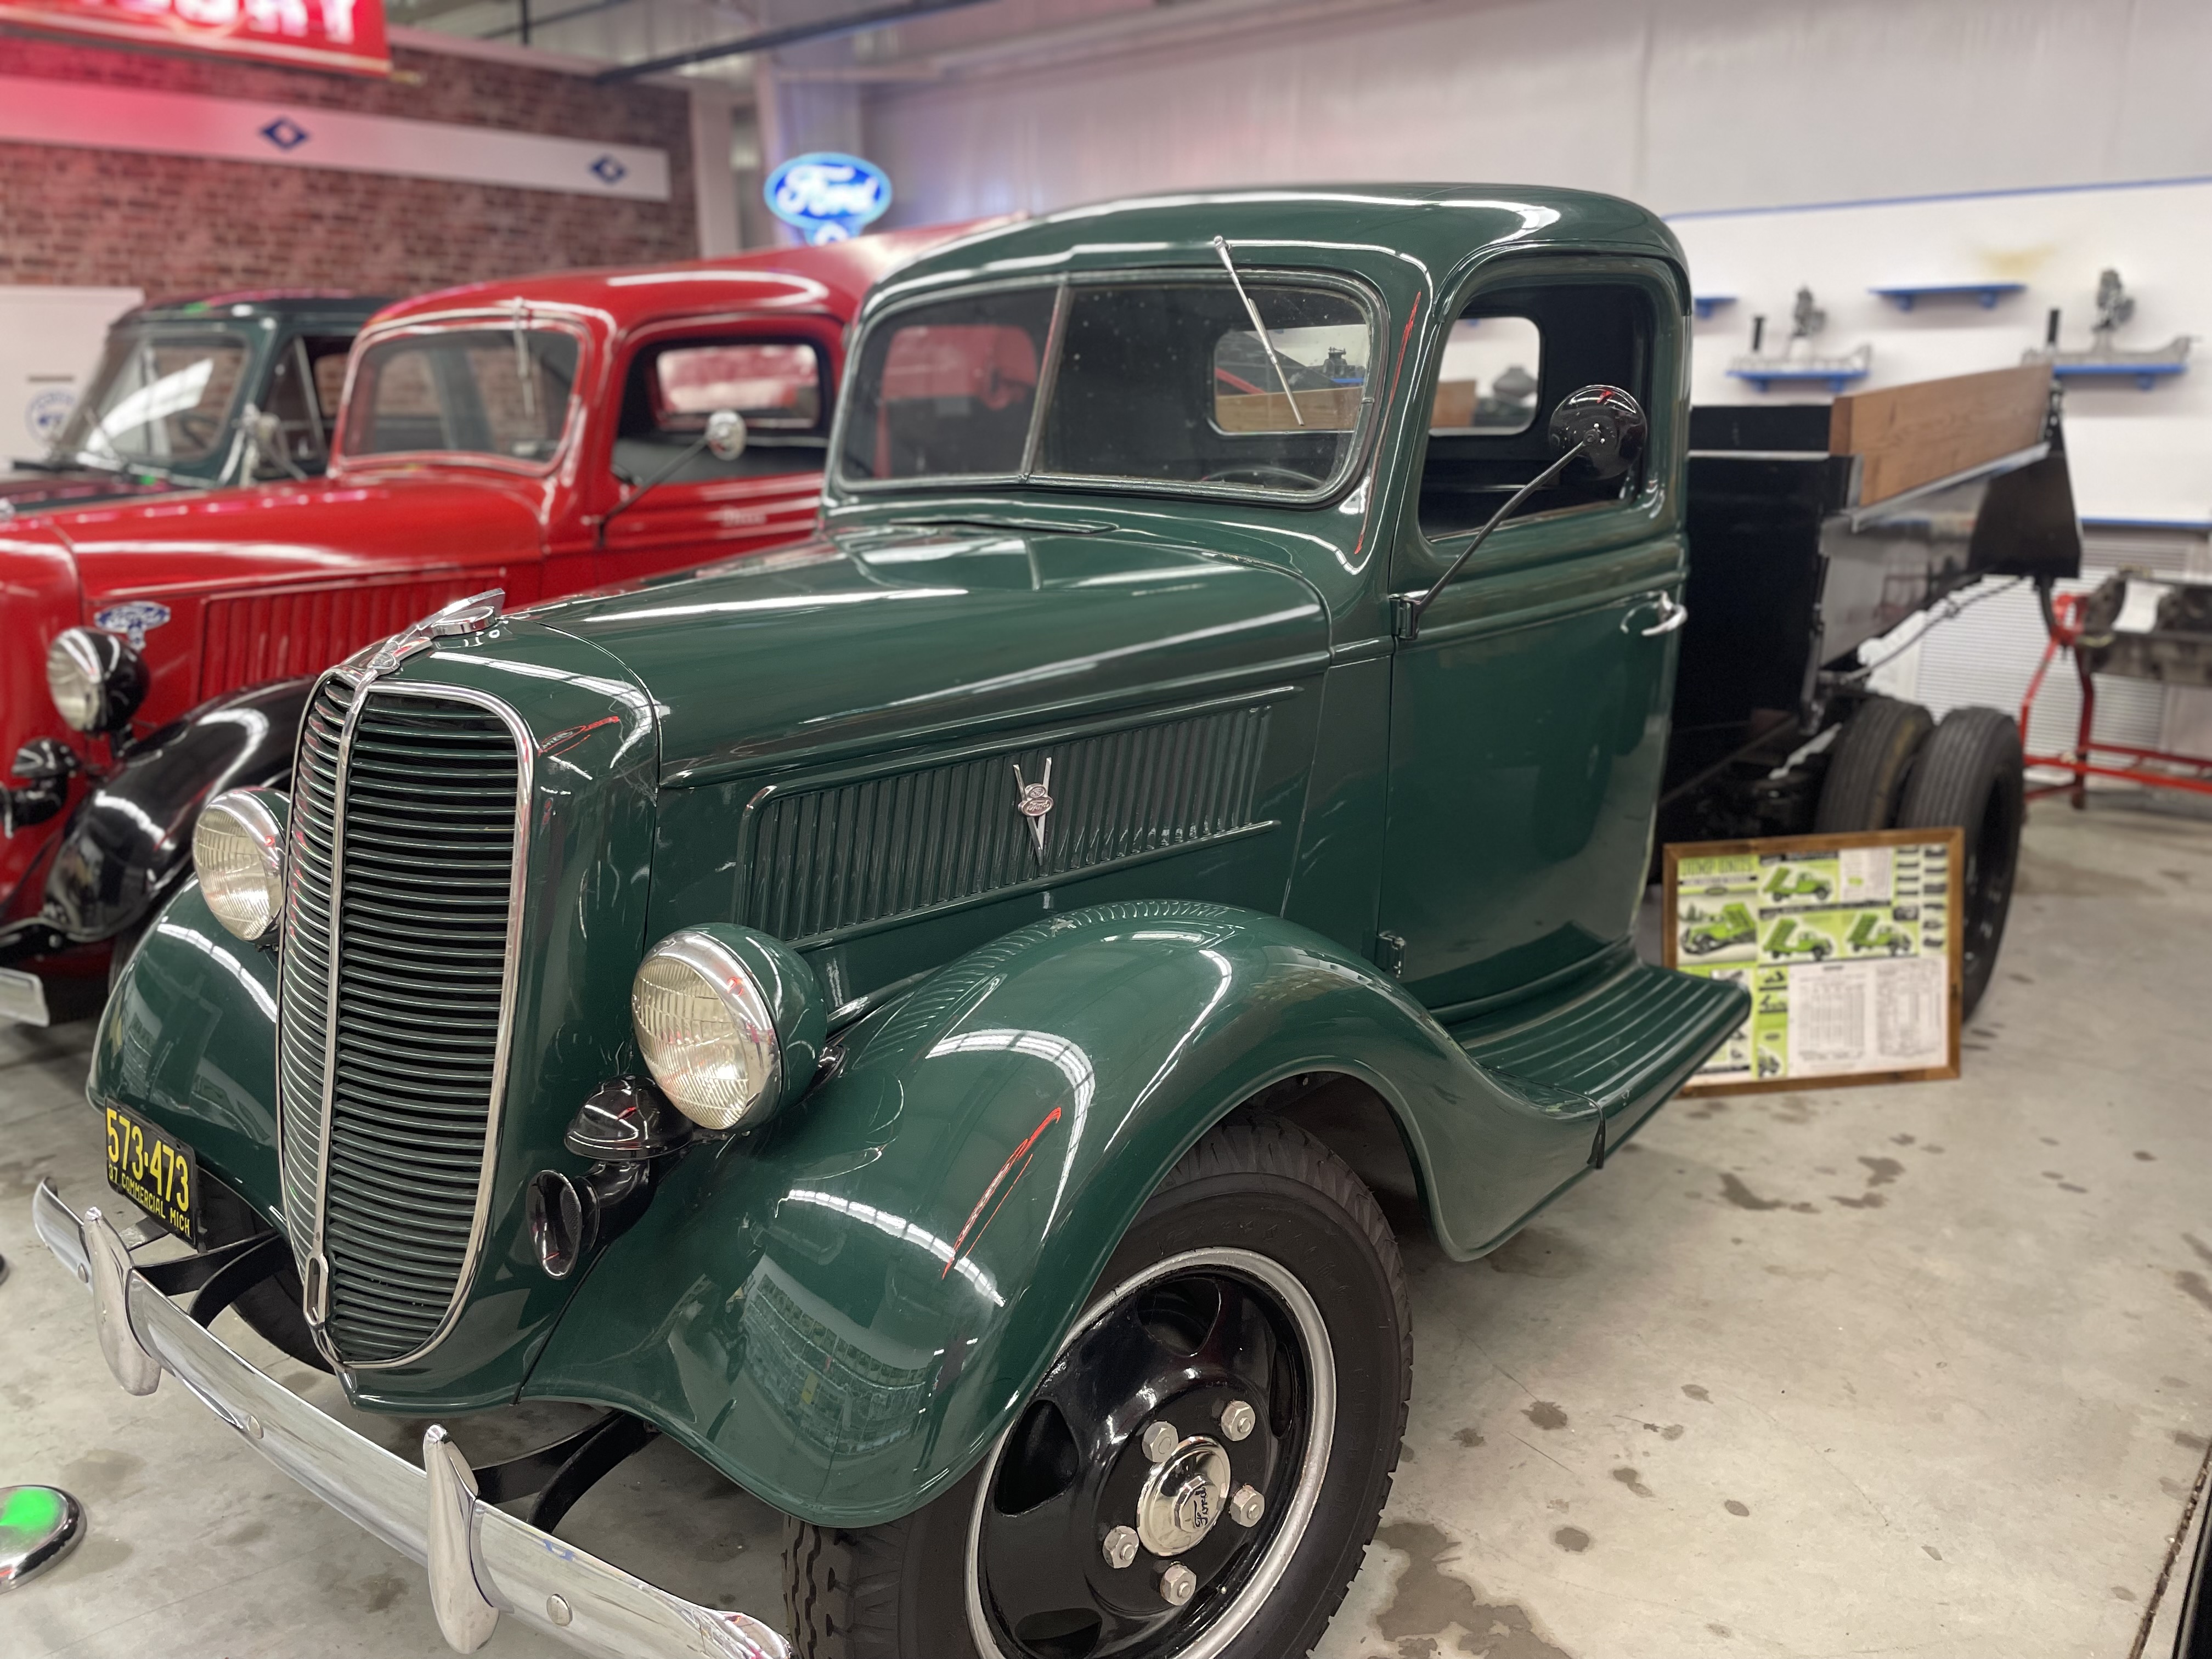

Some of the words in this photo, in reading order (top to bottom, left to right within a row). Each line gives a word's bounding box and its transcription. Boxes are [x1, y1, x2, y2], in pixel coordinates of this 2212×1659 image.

[109, 1164, 118, 1184] 37
[122, 1172, 166, 1219] COMMERCIAL
[170, 1207, 190, 1236] MICH
[1194, 1486, 1208, 1528] Ford
